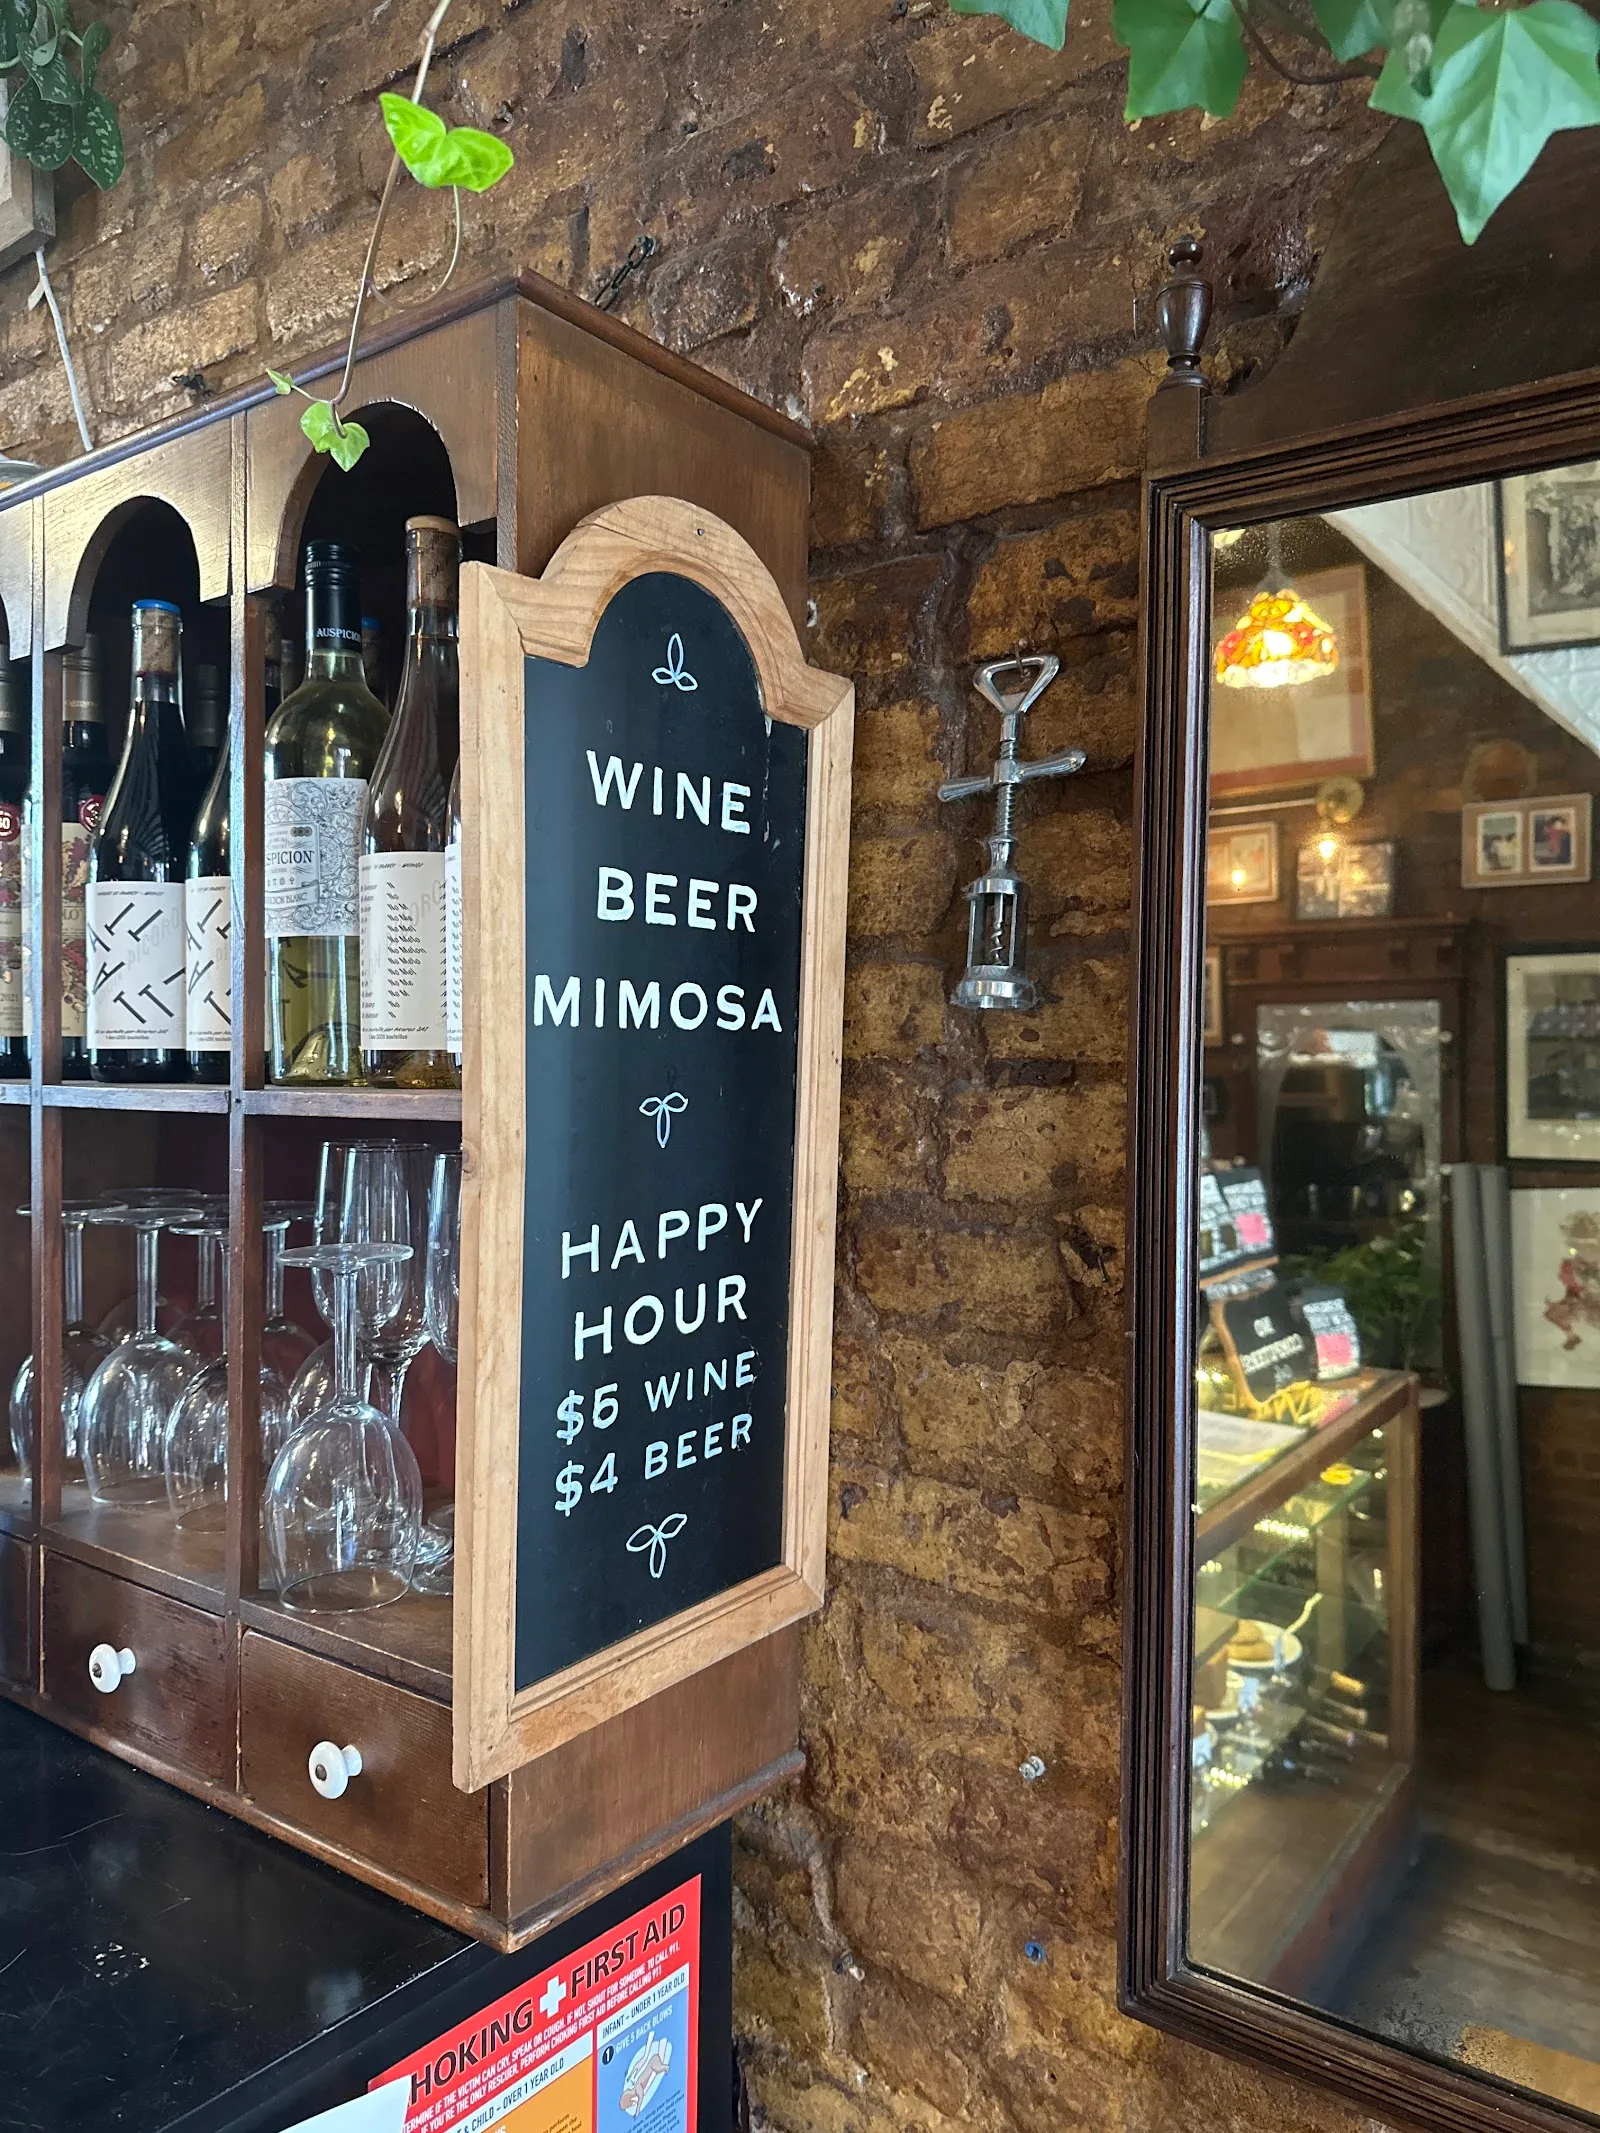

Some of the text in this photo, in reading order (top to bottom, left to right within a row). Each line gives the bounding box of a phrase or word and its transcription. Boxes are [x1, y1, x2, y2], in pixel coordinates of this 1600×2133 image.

[586, 750, 750, 834] WINE
[597, 867, 757, 932] BEER
[533, 974, 783, 1033] MIMOSA
[562, 1198, 763, 1279] HAPPY
[575, 1275, 747, 1361] HOUR
[645, 1351, 755, 1412] WINE
[554, 1414, 752, 1517] $4 BEER
[402, 2104, 435, 2133] TERMINE
[435, 2100, 444, 2115] IF
[443, 2092, 457, 2108] THE
[457, 2073, 482, 2099] VICTIM
[481, 2064, 497, 2086] CAN
[511, 2039, 533, 2064] SPEAK
[533, 2031, 543, 2046] OR
[566, 2012, 574, 2025] IF
[586, 1990, 607, 2011] SHOUT
[606, 1983, 620, 2000] FOR
[618, 1966, 646, 1993] SOMEONE
[647, 1957, 655, 1969] TO
[655, 1949, 669, 1966] CALL
[408, 1903, 686, 2107] HOKING FIRST AID
[602, 2014, 625, 2039] INFANT
[630, 1996, 652, 2018] UNDER
[657, 1982, 673, 2001] YEAR
[673, 1971, 686, 1988] OLD
[615, 2004, 674, 2055] GIVE 5 BACK BLOWS
[420, 2123, 429, 2133] IF
[429, 2107, 456, 2133] YOU'RE
[456, 2097, 470, 2114] THE
[469, 2083, 487, 2106] ONLY
[520, 2042, 550, 2070] PERFORM
[549, 2022, 578, 2050] CHOKING
[577, 2012, 596, 2032] FIRST
[595, 2002, 607, 2019] AID
[606, 1990, 629, 2013] BEFORE
[628, 1973, 653, 2001] CALLING
[651, 1965, 663, 1981] 911
[471, 2105, 495, 2133] CHILD
[502, 2086, 523, 2110] OVER
[530, 2071, 550, 2091] YEAR
[550, 2057, 565, 2076] OLD
